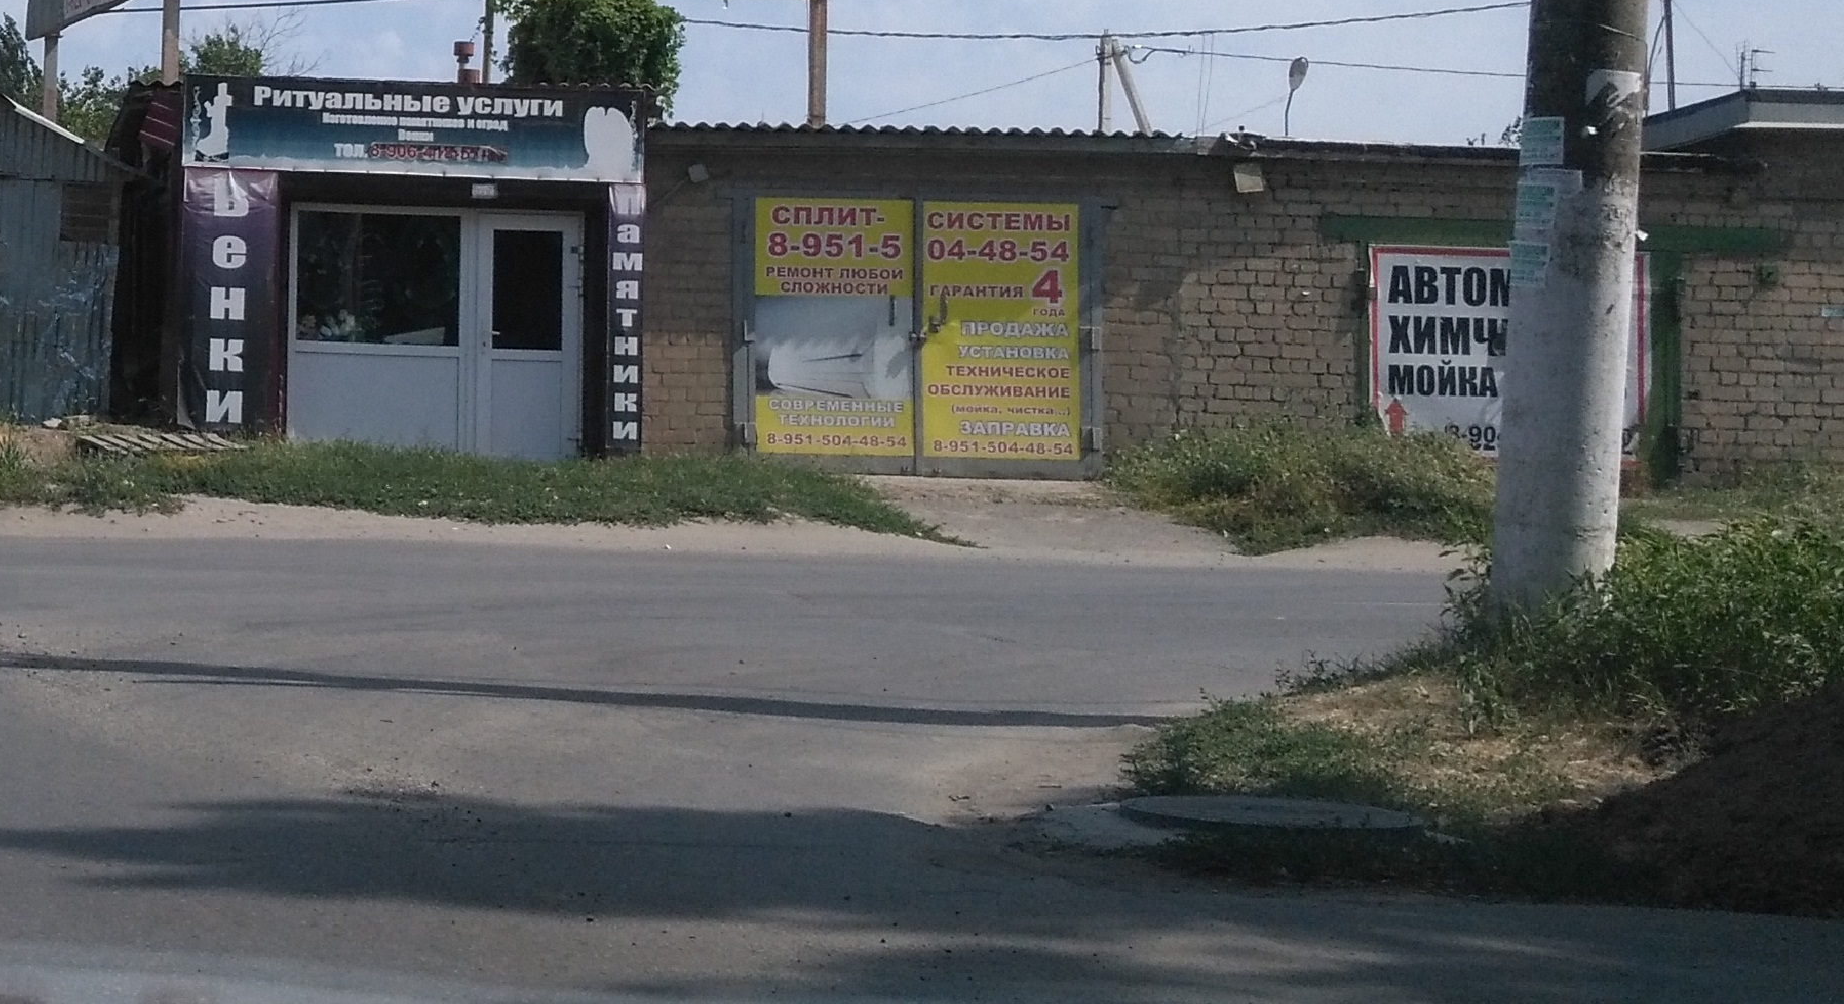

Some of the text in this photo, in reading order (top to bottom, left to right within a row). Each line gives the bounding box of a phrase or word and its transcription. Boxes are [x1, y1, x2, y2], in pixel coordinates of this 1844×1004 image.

[253, 86, 563, 118] Ритуальные услуги
[771, 205, 885, 226] СПЛИТ-
[927, 211, 1070, 231] СИСТЕМЫ
[767, 232, 901, 259] 8-951-5
[927, 239, 1069, 262] 04-48-54
[765, 266, 834, 279] РЕМОНТ
[780, 281, 888, 295] СЛОЖНОСТИ
[930, 285, 1023, 298] ГАРАНТИЯ
[1031, 269, 1063, 304] 4
[1033, 308, 1065, 317] ГОДА
[960, 321, 1069, 338] ПРОДАЖА
[1388, 315, 1509, 357] ХИМЧ
[958, 345, 1069, 360] УСТАНОВКА
[946, 365, 1070, 379] ТЕХНИЧЕСКОЕ
[1387, 359, 1499, 398] МОЙКА
[927, 383, 1070, 399] ОБСЛУЖИВАНИЕ
[768, 399, 904, 413] СОВРЕМЕННЫЕ
[779, 414, 895, 428] ТЕХНОЛОГИИ
[959, 420, 1071, 437] ЗАПРАВКА
[766, 433, 907, 447] 8-951-504-48-54
[933, 439, 1074, 455] 8-951-504-48-54
